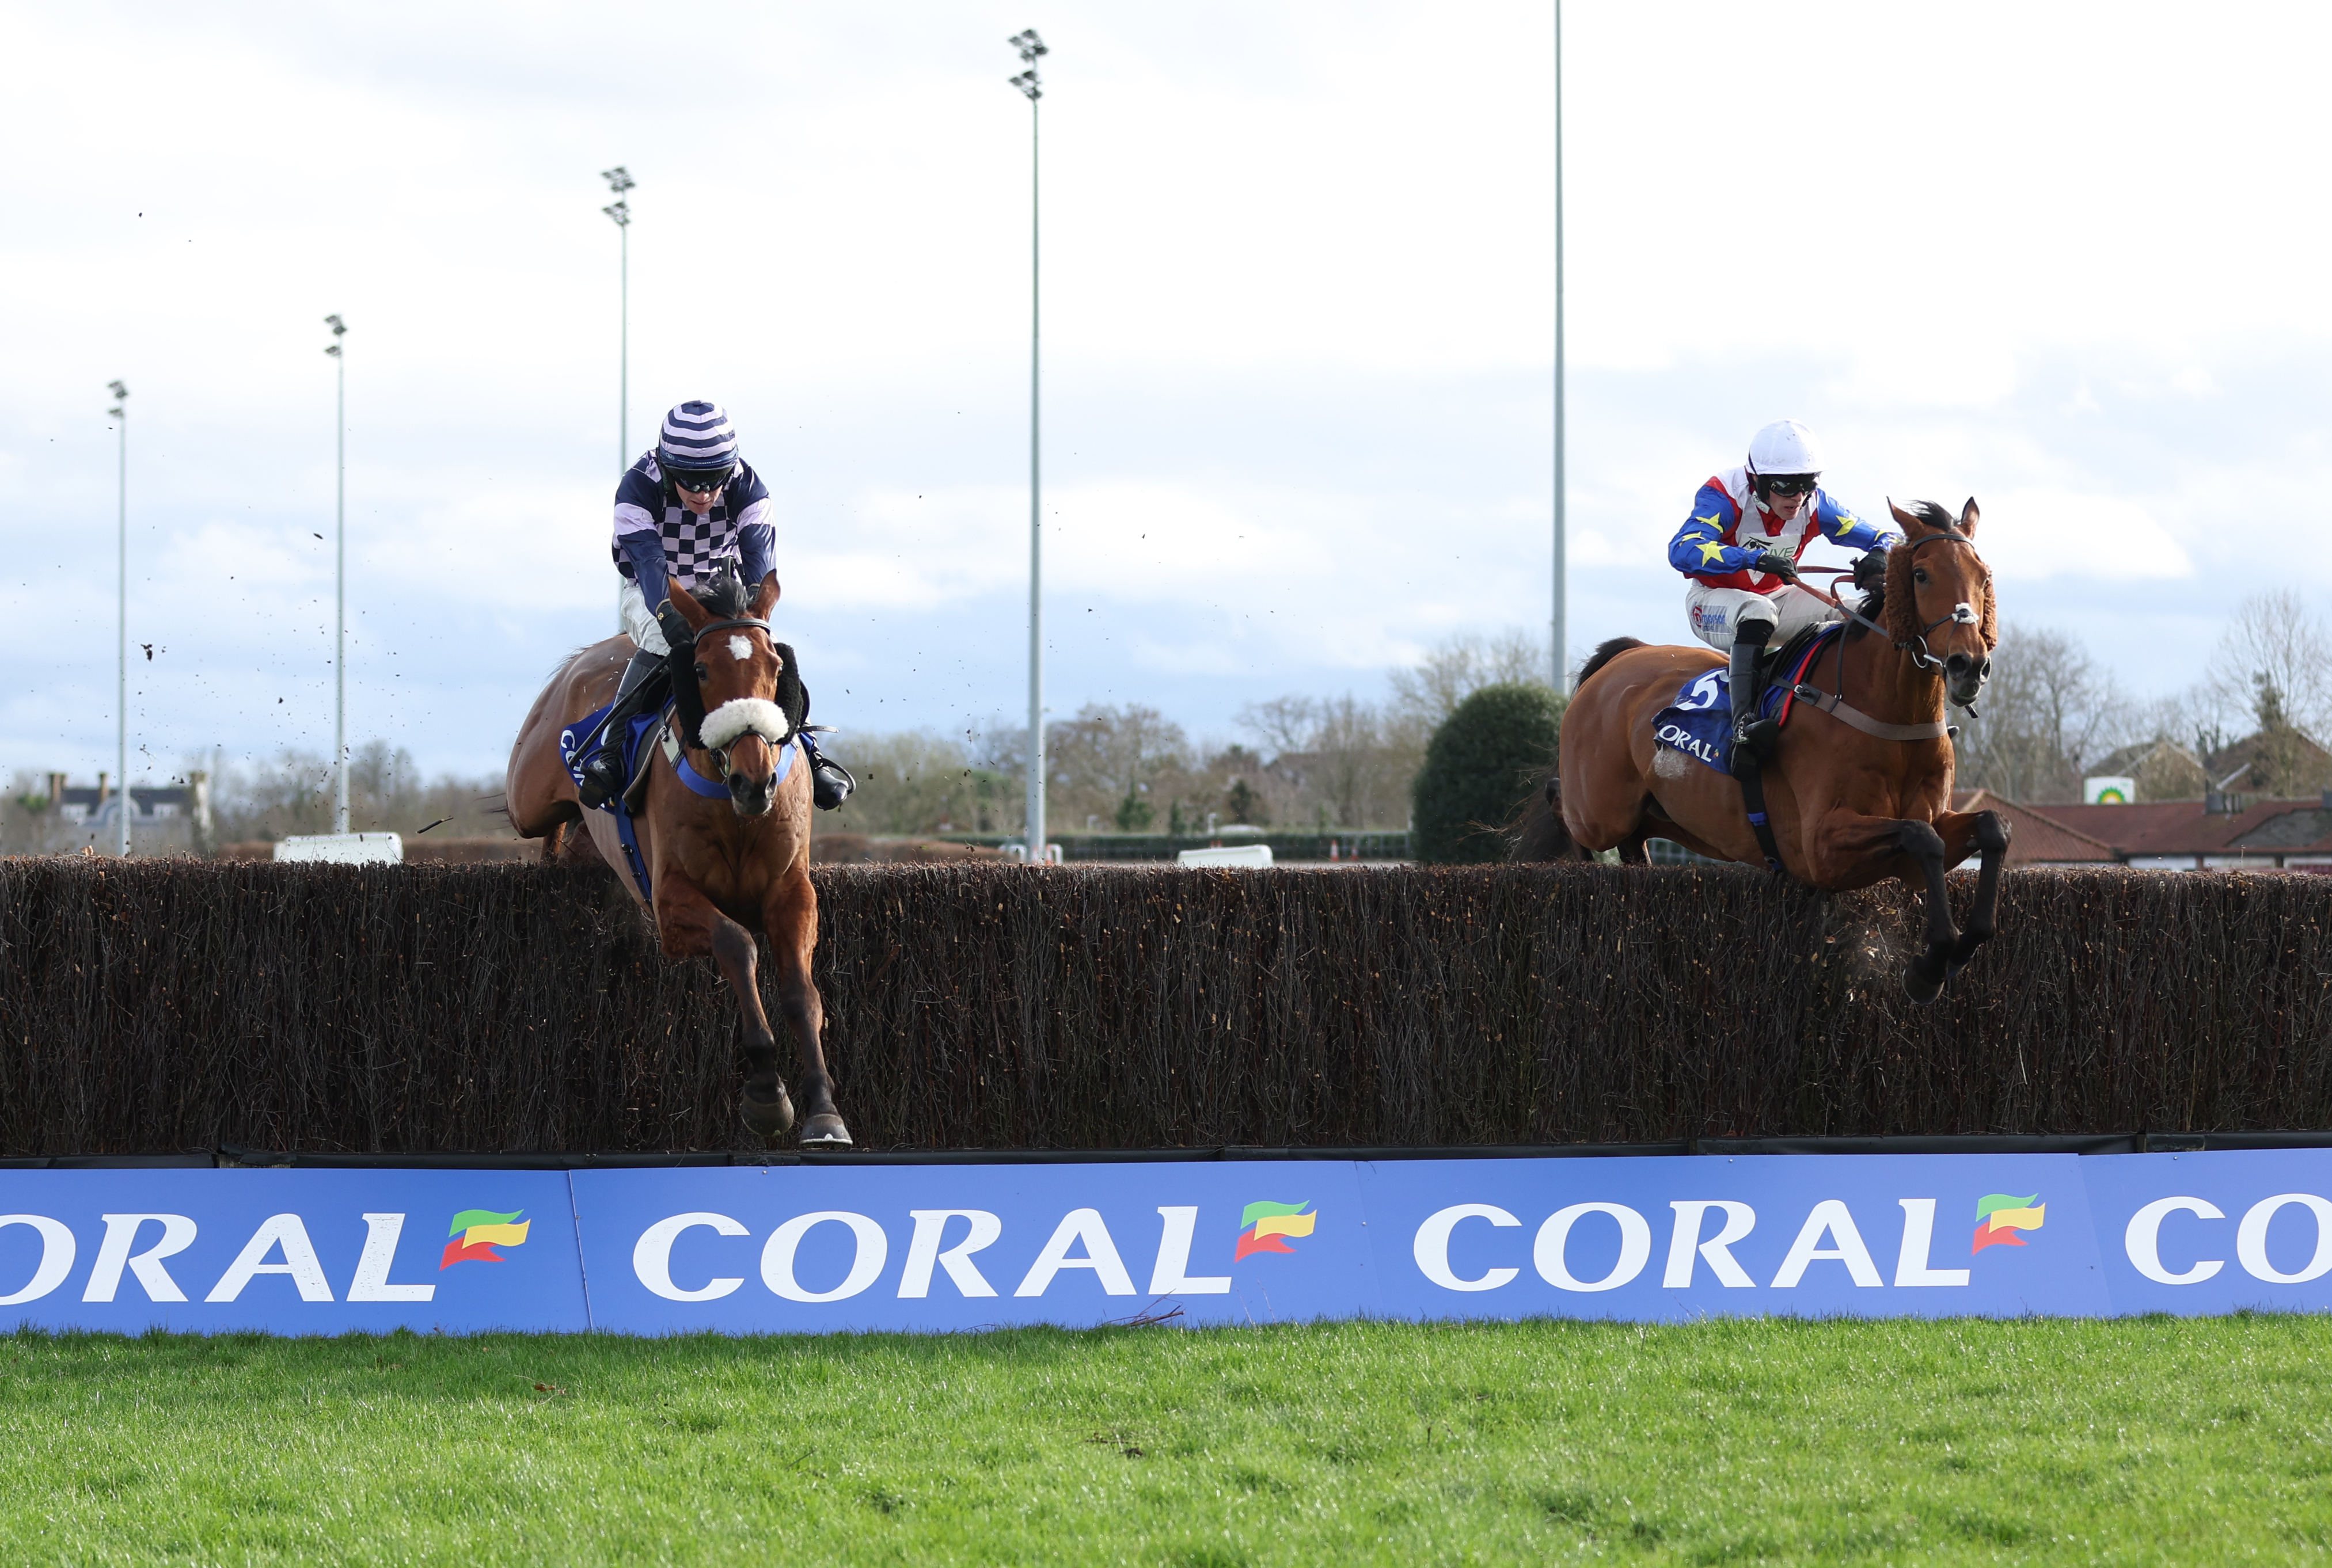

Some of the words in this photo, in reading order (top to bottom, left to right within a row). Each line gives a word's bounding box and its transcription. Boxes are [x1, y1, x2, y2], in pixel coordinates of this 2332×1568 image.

[1676, 669, 1729, 710] 5
[1659, 725, 1712, 763] ORAL
[633, 1206, 1232, 1303] CORAL
[1413, 1198, 1970, 1292] CORAL
